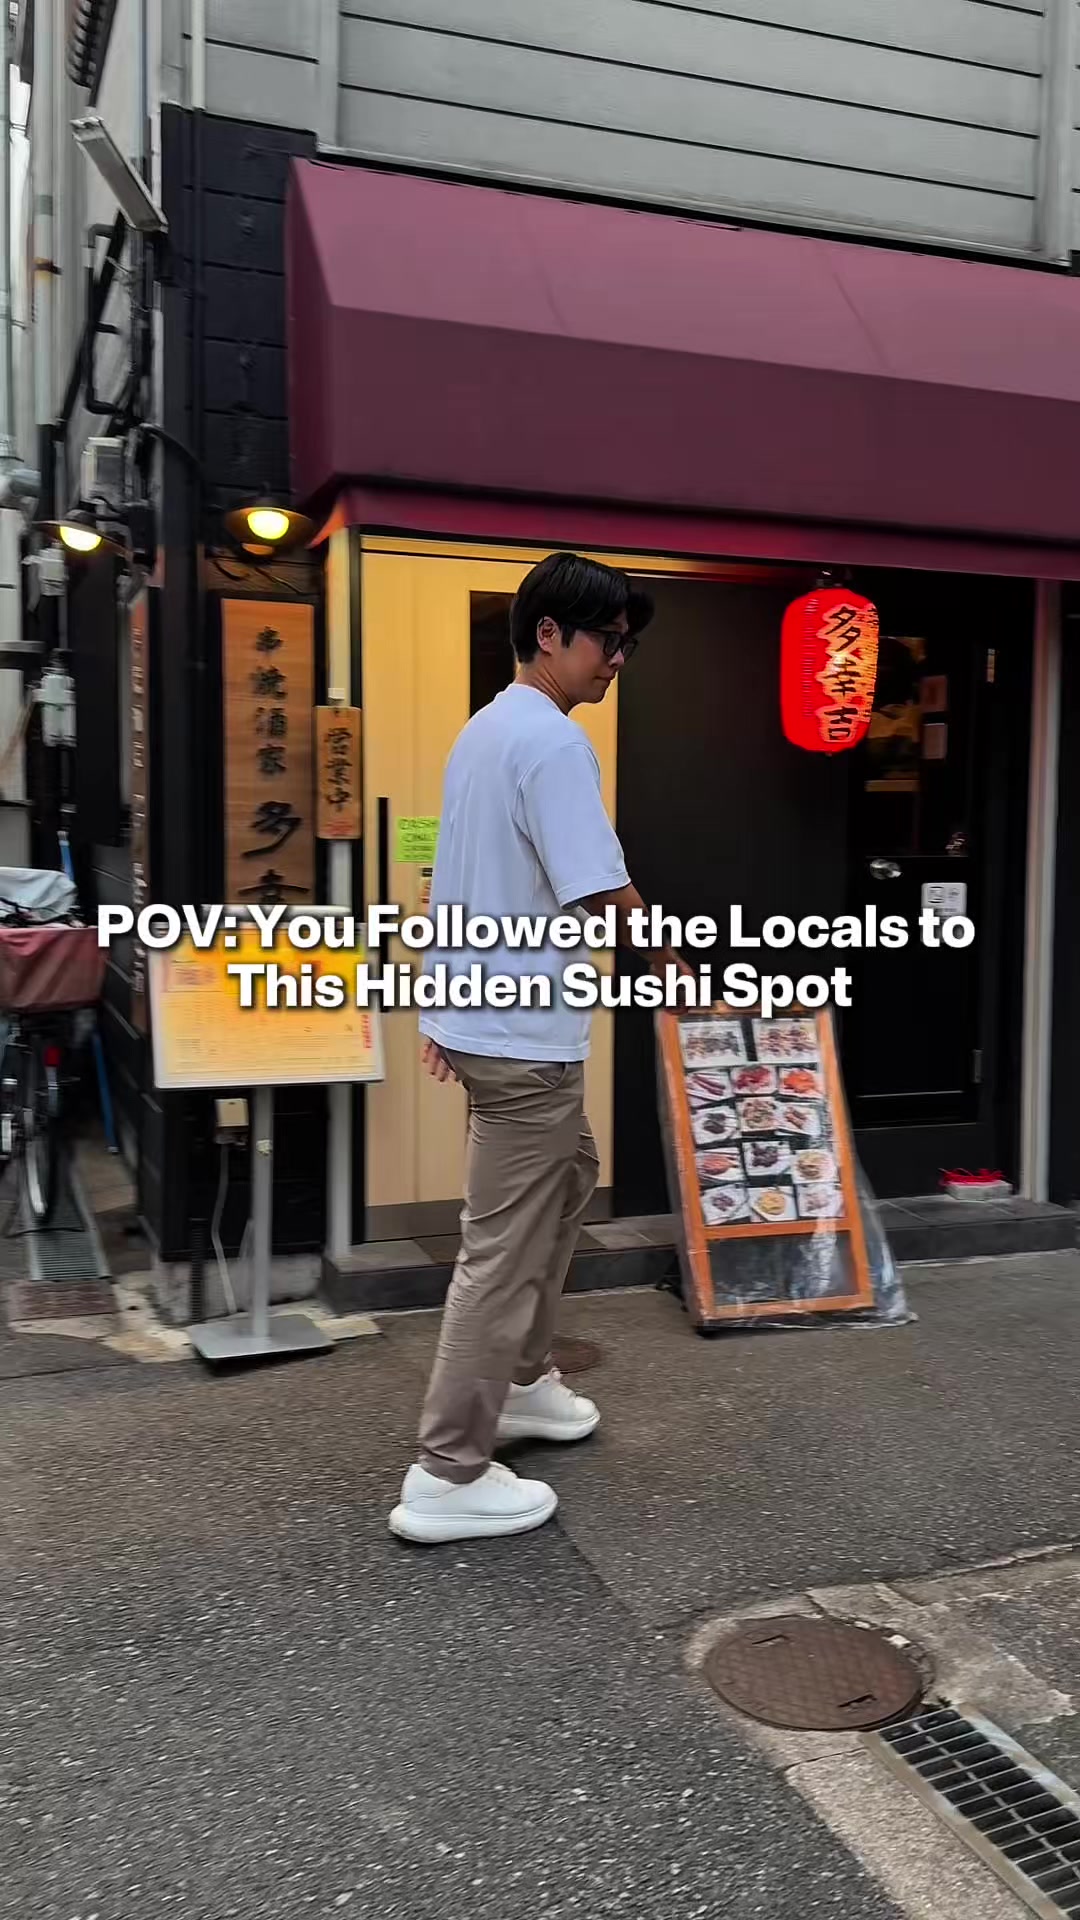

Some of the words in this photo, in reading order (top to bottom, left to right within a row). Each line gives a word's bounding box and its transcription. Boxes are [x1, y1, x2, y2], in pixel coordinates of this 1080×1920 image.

[822, 605, 861, 741] 多幸吉
[323, 727, 353, 813] 営業中
